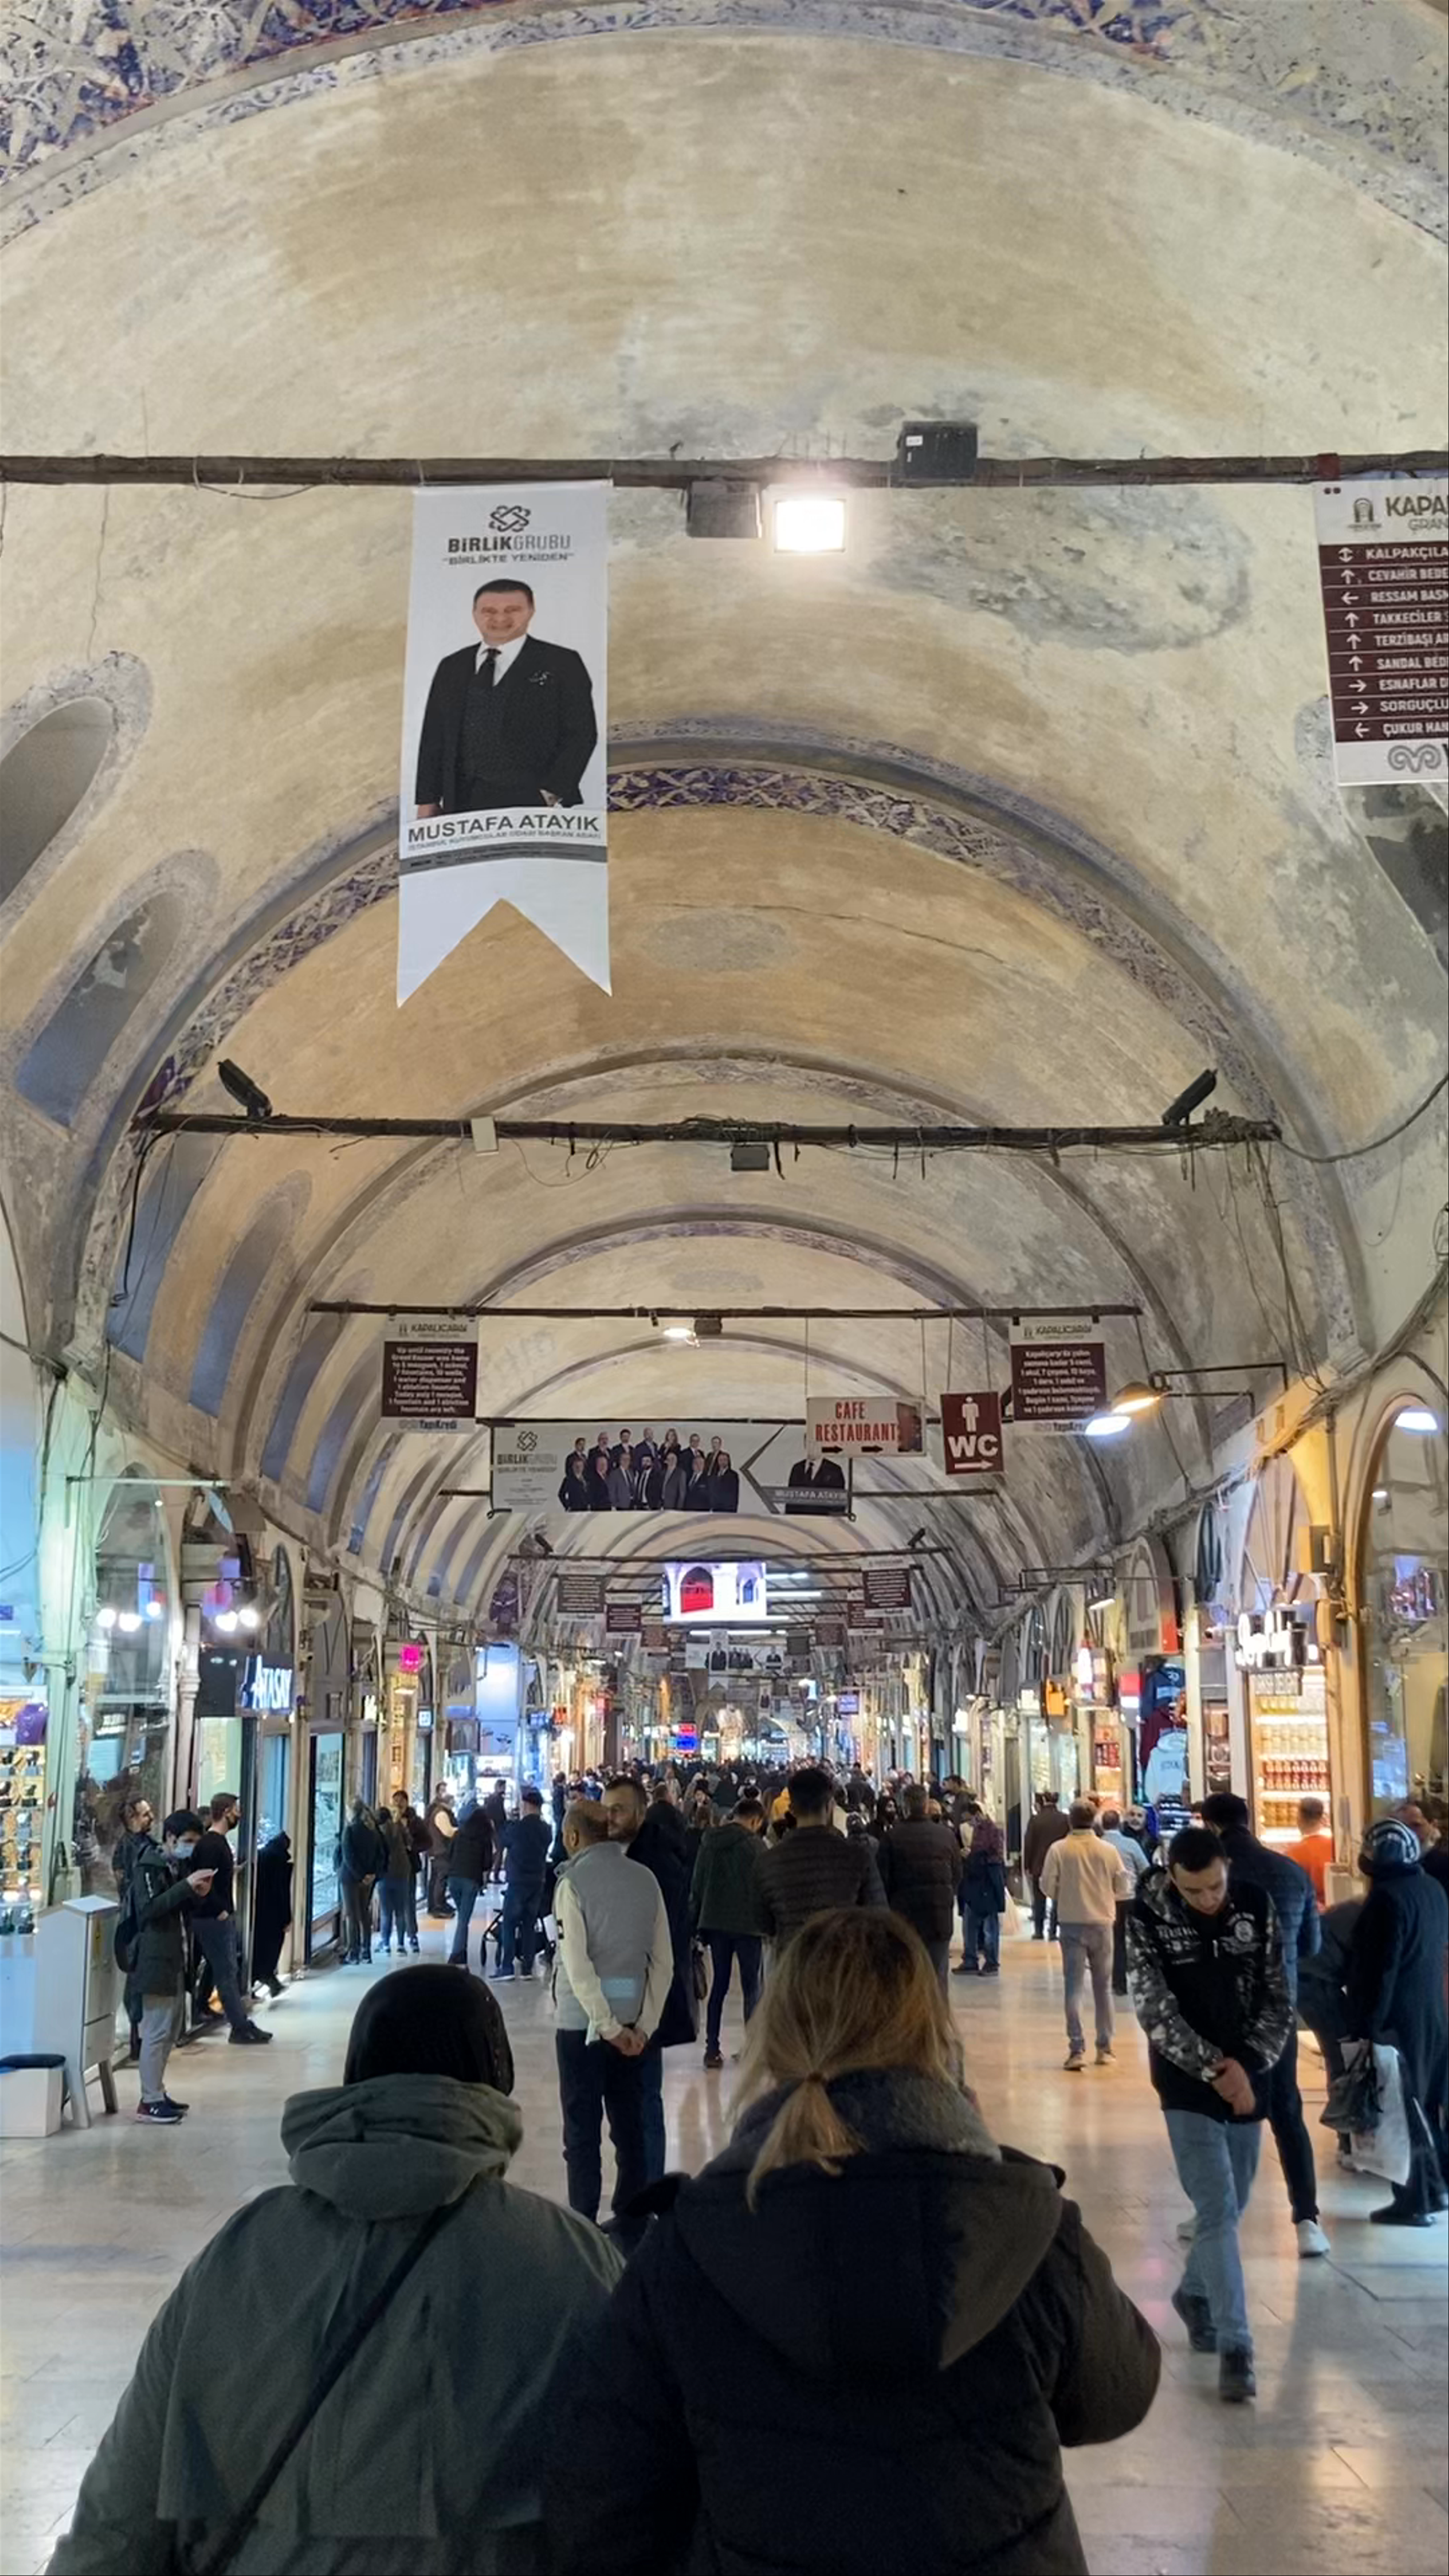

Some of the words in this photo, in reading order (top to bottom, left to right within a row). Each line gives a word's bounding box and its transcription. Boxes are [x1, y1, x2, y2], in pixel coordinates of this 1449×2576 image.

[1385, 495, 1448, 517] KAPA
[1371, 590, 1418, 603] RESSAM
[1377, 657, 1422, 670] SANDAL
[1379, 678, 1437, 691] ESNAFLAR
[1383, 723, 1424, 738] ÇUKUR
[408, 815, 513, 843] MUSTAFA
[519, 815, 599, 832] ATAYIK
[835, 1402, 866, 1420] CAFE
[815, 1423, 897, 1442] RESTAURANT
[948, 1435, 998, 1458] WC
